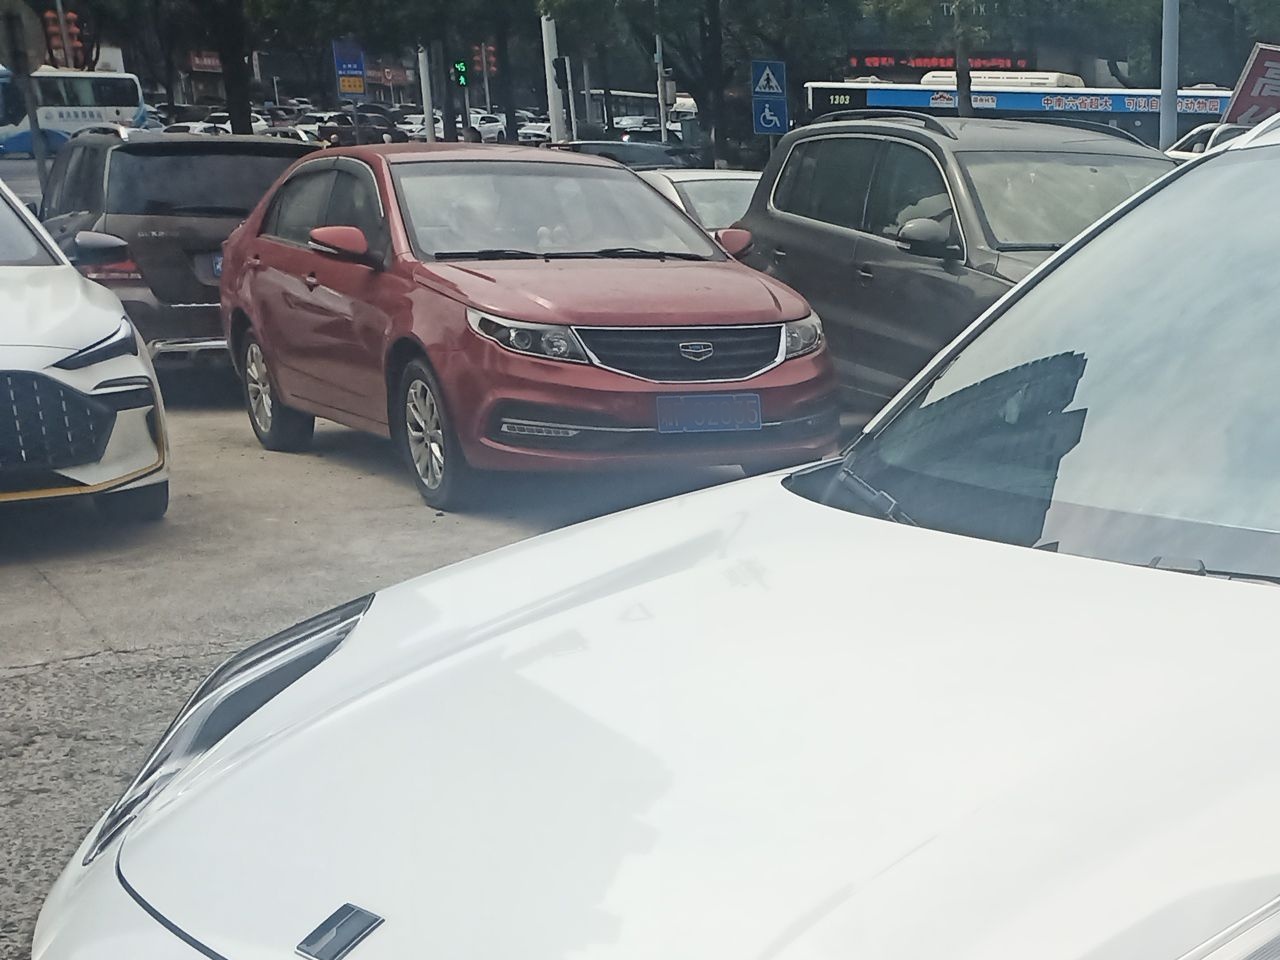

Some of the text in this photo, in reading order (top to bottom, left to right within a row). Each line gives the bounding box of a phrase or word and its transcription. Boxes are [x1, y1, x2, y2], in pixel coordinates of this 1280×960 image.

[829, 95, 850, 105] 1303
[1125, 97, 1220, 113] 可以自的动物园
